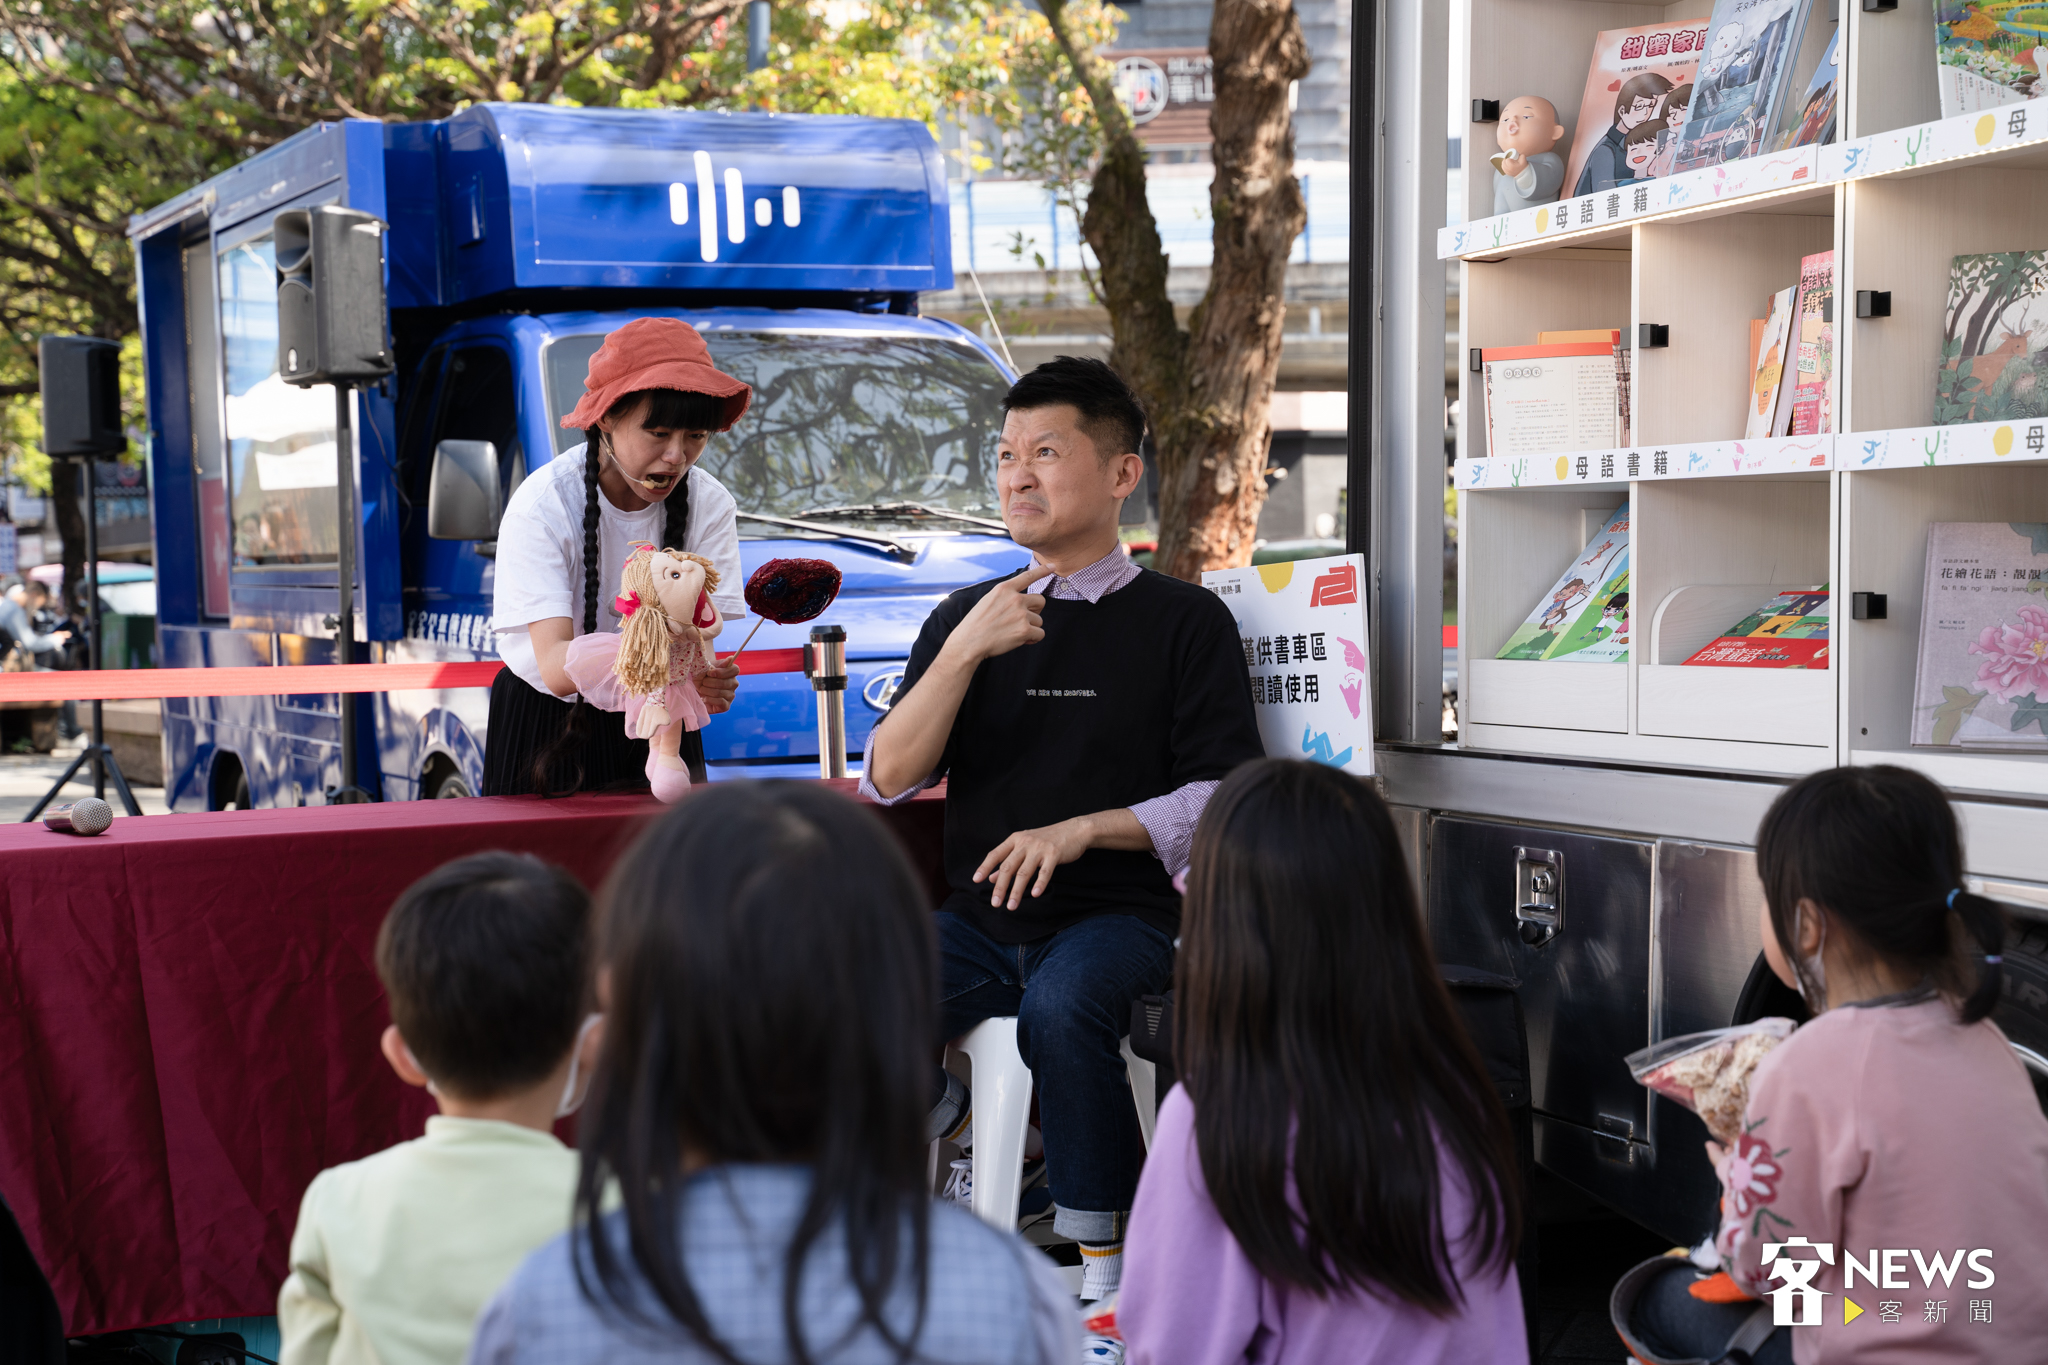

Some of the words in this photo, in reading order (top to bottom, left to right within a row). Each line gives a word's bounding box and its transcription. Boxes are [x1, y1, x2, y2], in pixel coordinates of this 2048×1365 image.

[2007, 109, 2027, 138] 母
[1555, 186, 1648, 229] 母語書籍
[2026, 425, 2045, 454] 母
[1575, 450, 1668, 479] 母語書籍
[1241, 632, 1327, 667] 僅供書車區
[1250, 674, 1320, 704] 閱讀使用
